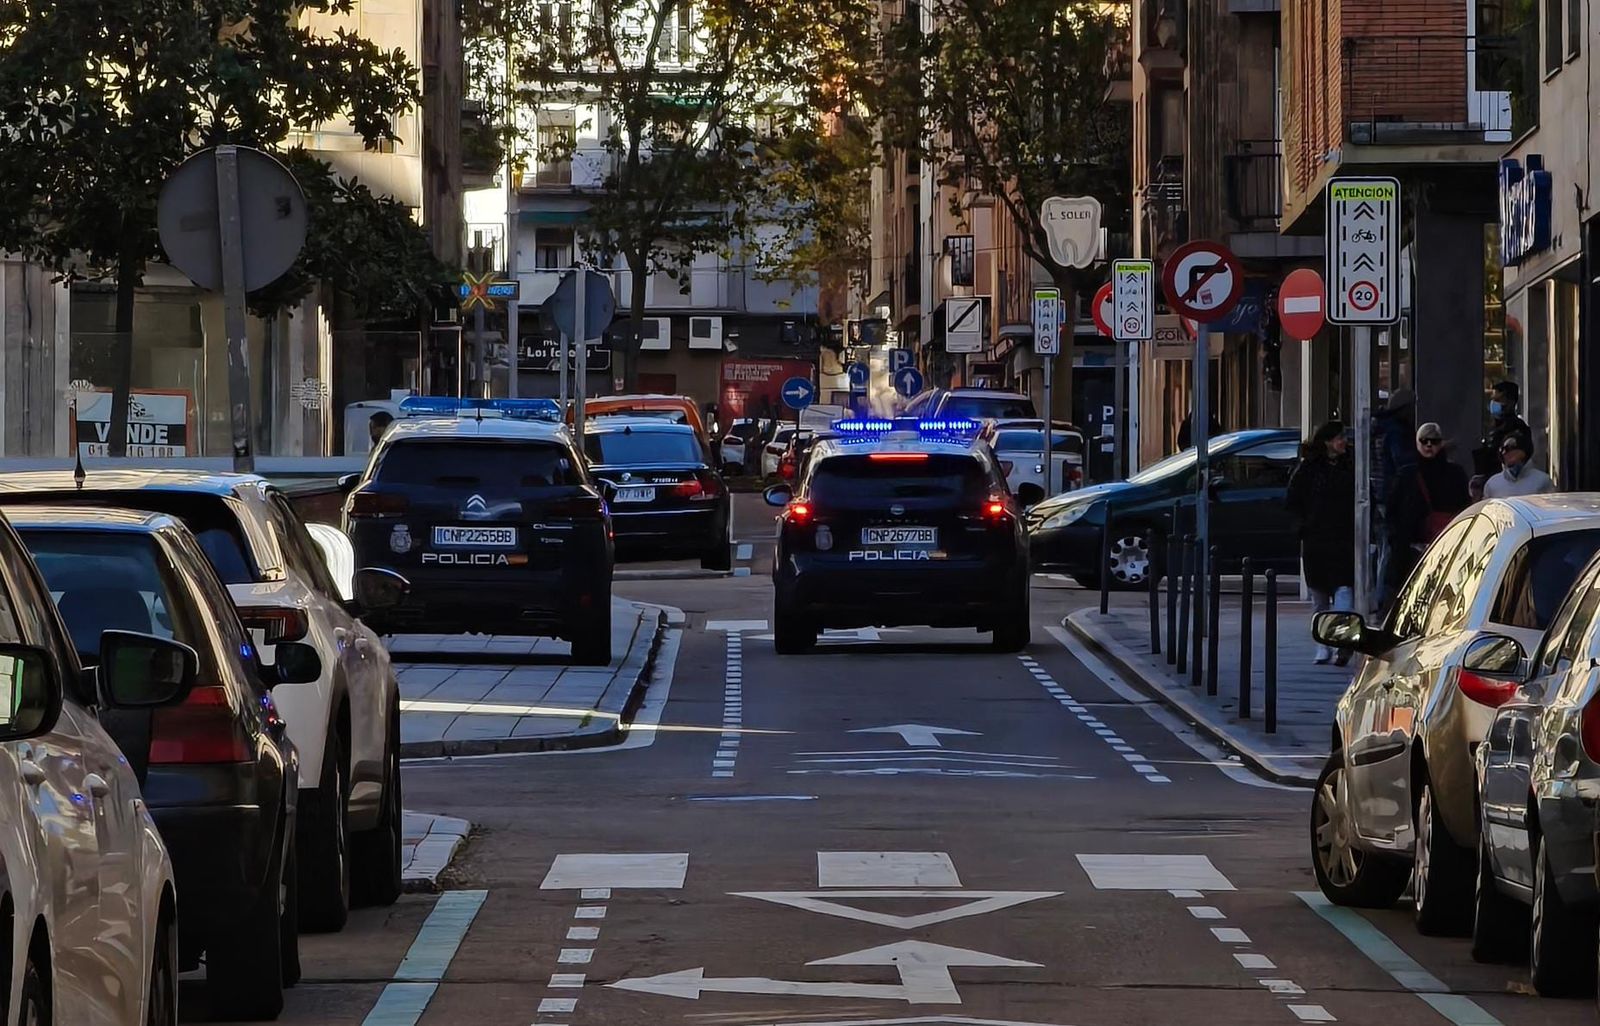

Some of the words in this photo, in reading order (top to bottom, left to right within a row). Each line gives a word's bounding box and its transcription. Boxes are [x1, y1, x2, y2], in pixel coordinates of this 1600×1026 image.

[1355, 290, 1373, 301] 20
[893, 350, 910, 371] P
[1103, 405, 1115, 421] P
[95, 422, 168, 444] VNDE
[443, 529, 512, 543] CNP2255BB
[868, 529, 933, 542] CNP2677BB
[421, 553, 509, 565] POLICIA
[849, 550, 930, 561] POLICIA
